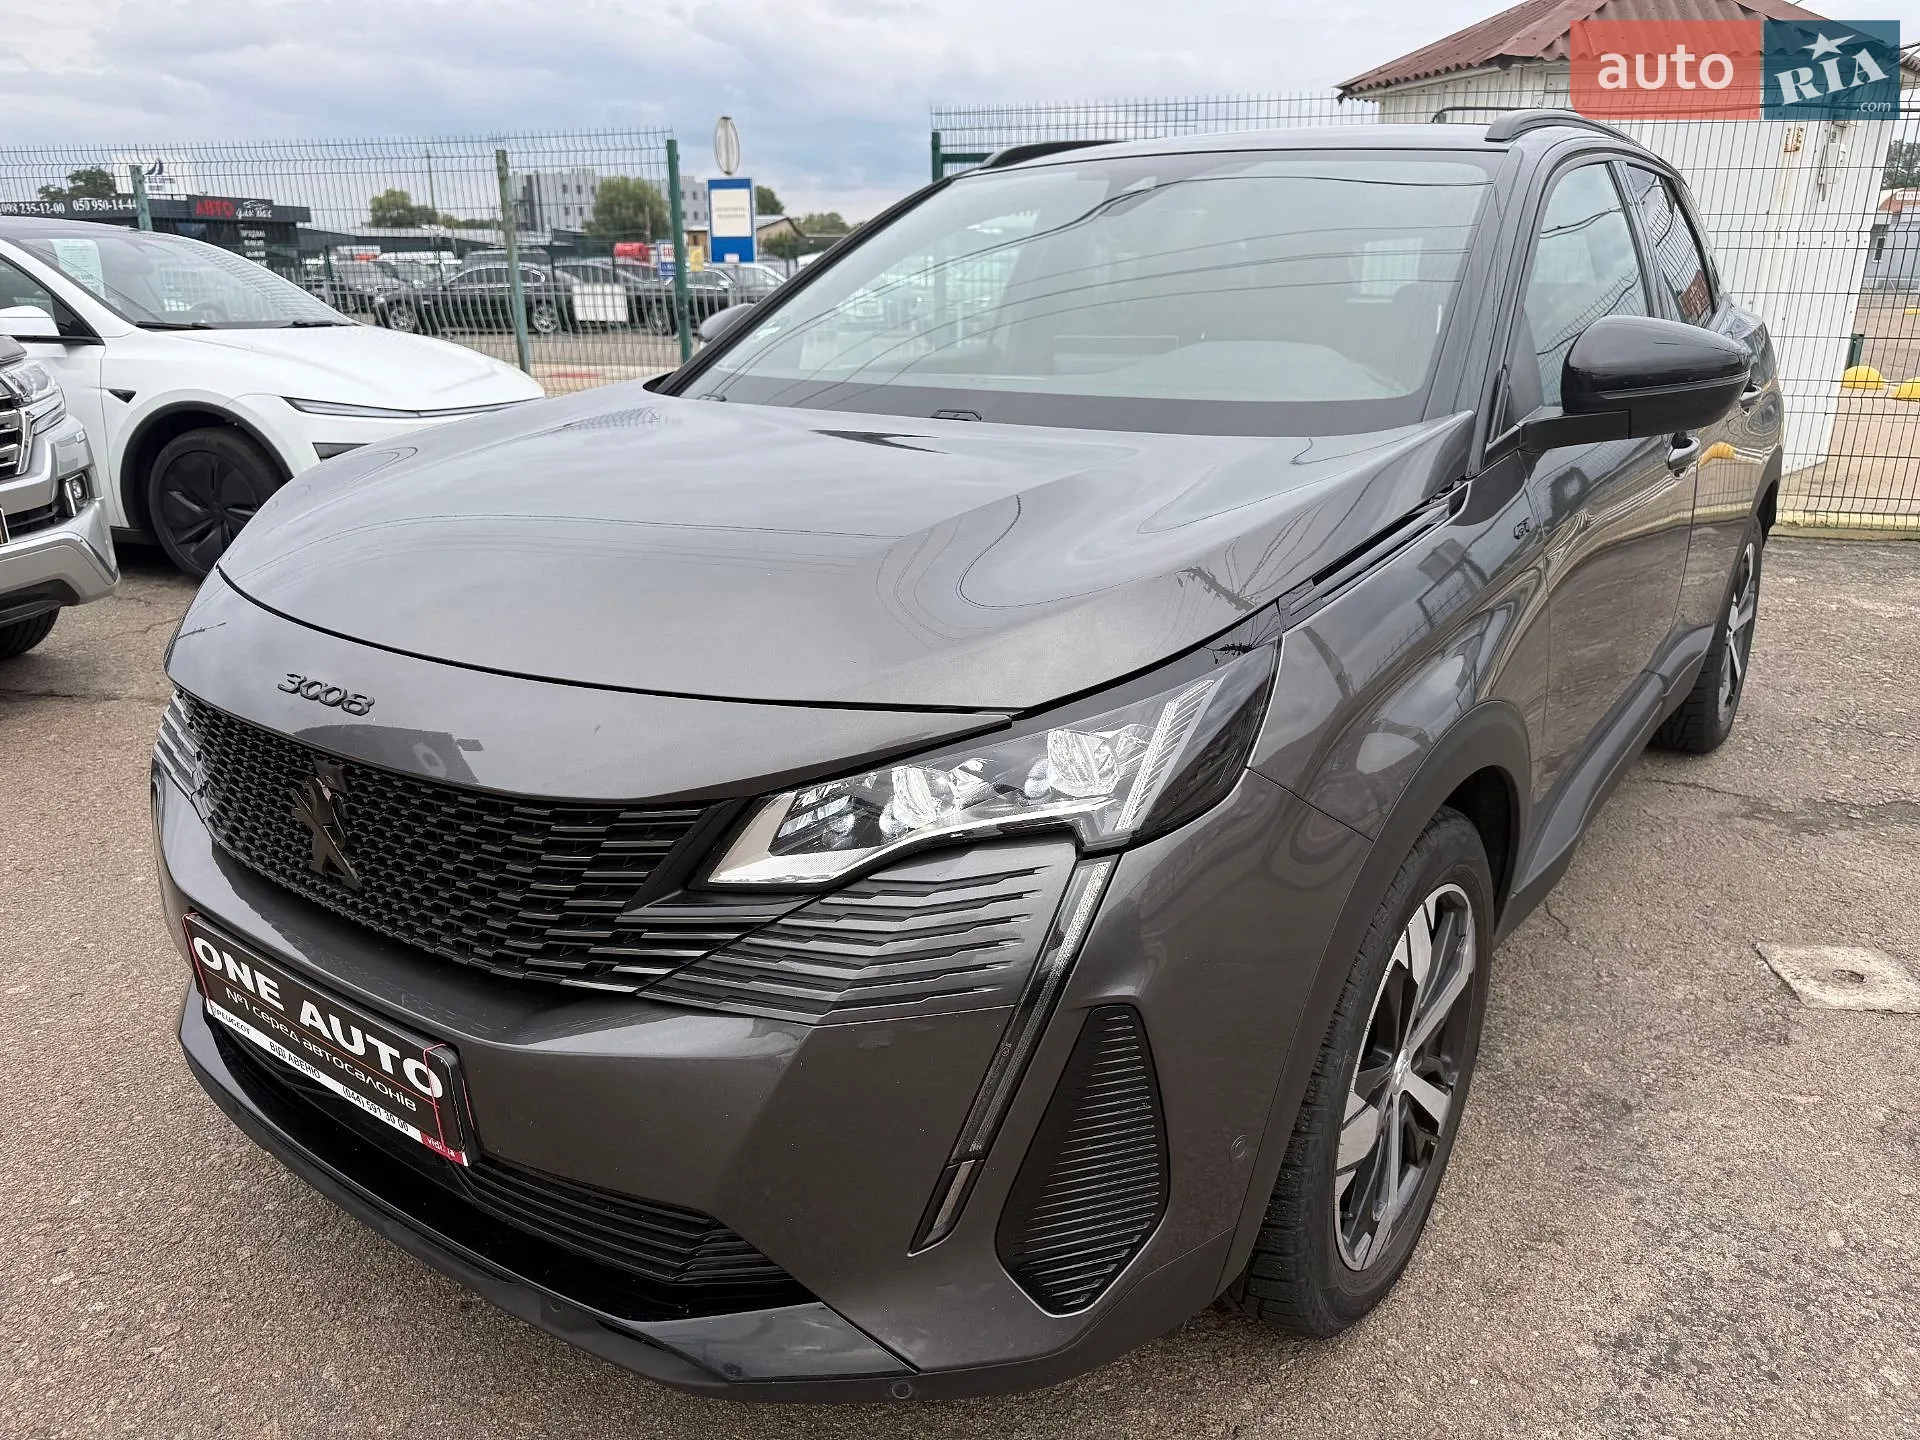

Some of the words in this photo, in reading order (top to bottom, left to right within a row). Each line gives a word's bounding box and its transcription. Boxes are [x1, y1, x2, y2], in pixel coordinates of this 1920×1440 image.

[20, 202, 65, 214] 235-12-00
[277, 672, 376, 717] 3008
[194, 937, 285, 1012] ONE
[300, 999, 443, 1099] AUTO
[253, 1008, 301, 1044] серед
[303, 1038, 418, 1113] автосалонів
